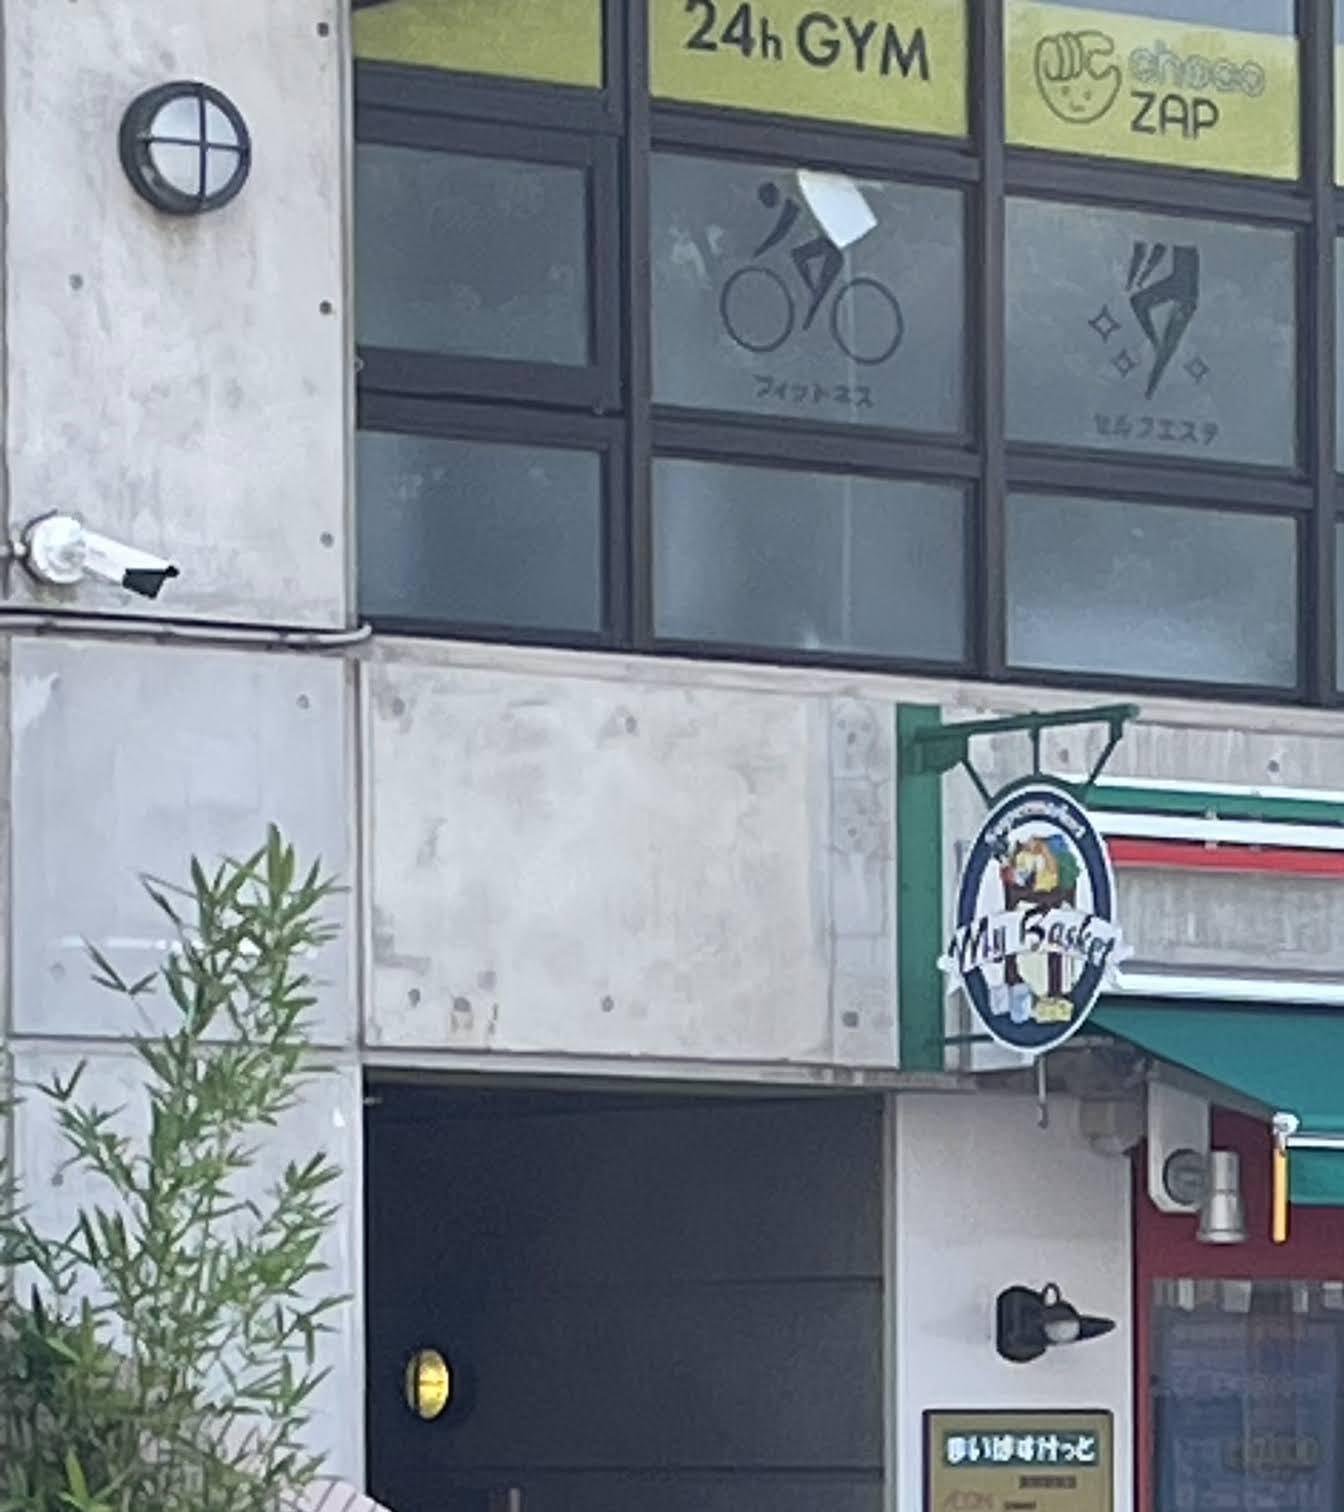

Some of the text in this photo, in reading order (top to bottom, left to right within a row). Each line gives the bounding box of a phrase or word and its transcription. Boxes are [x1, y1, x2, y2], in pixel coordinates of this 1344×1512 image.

[684, 0, 930, 82] 24h GYM
[1130, 92, 1221, 139] ZAP
[947, 1433, 1096, 1465] まいばすけっと
